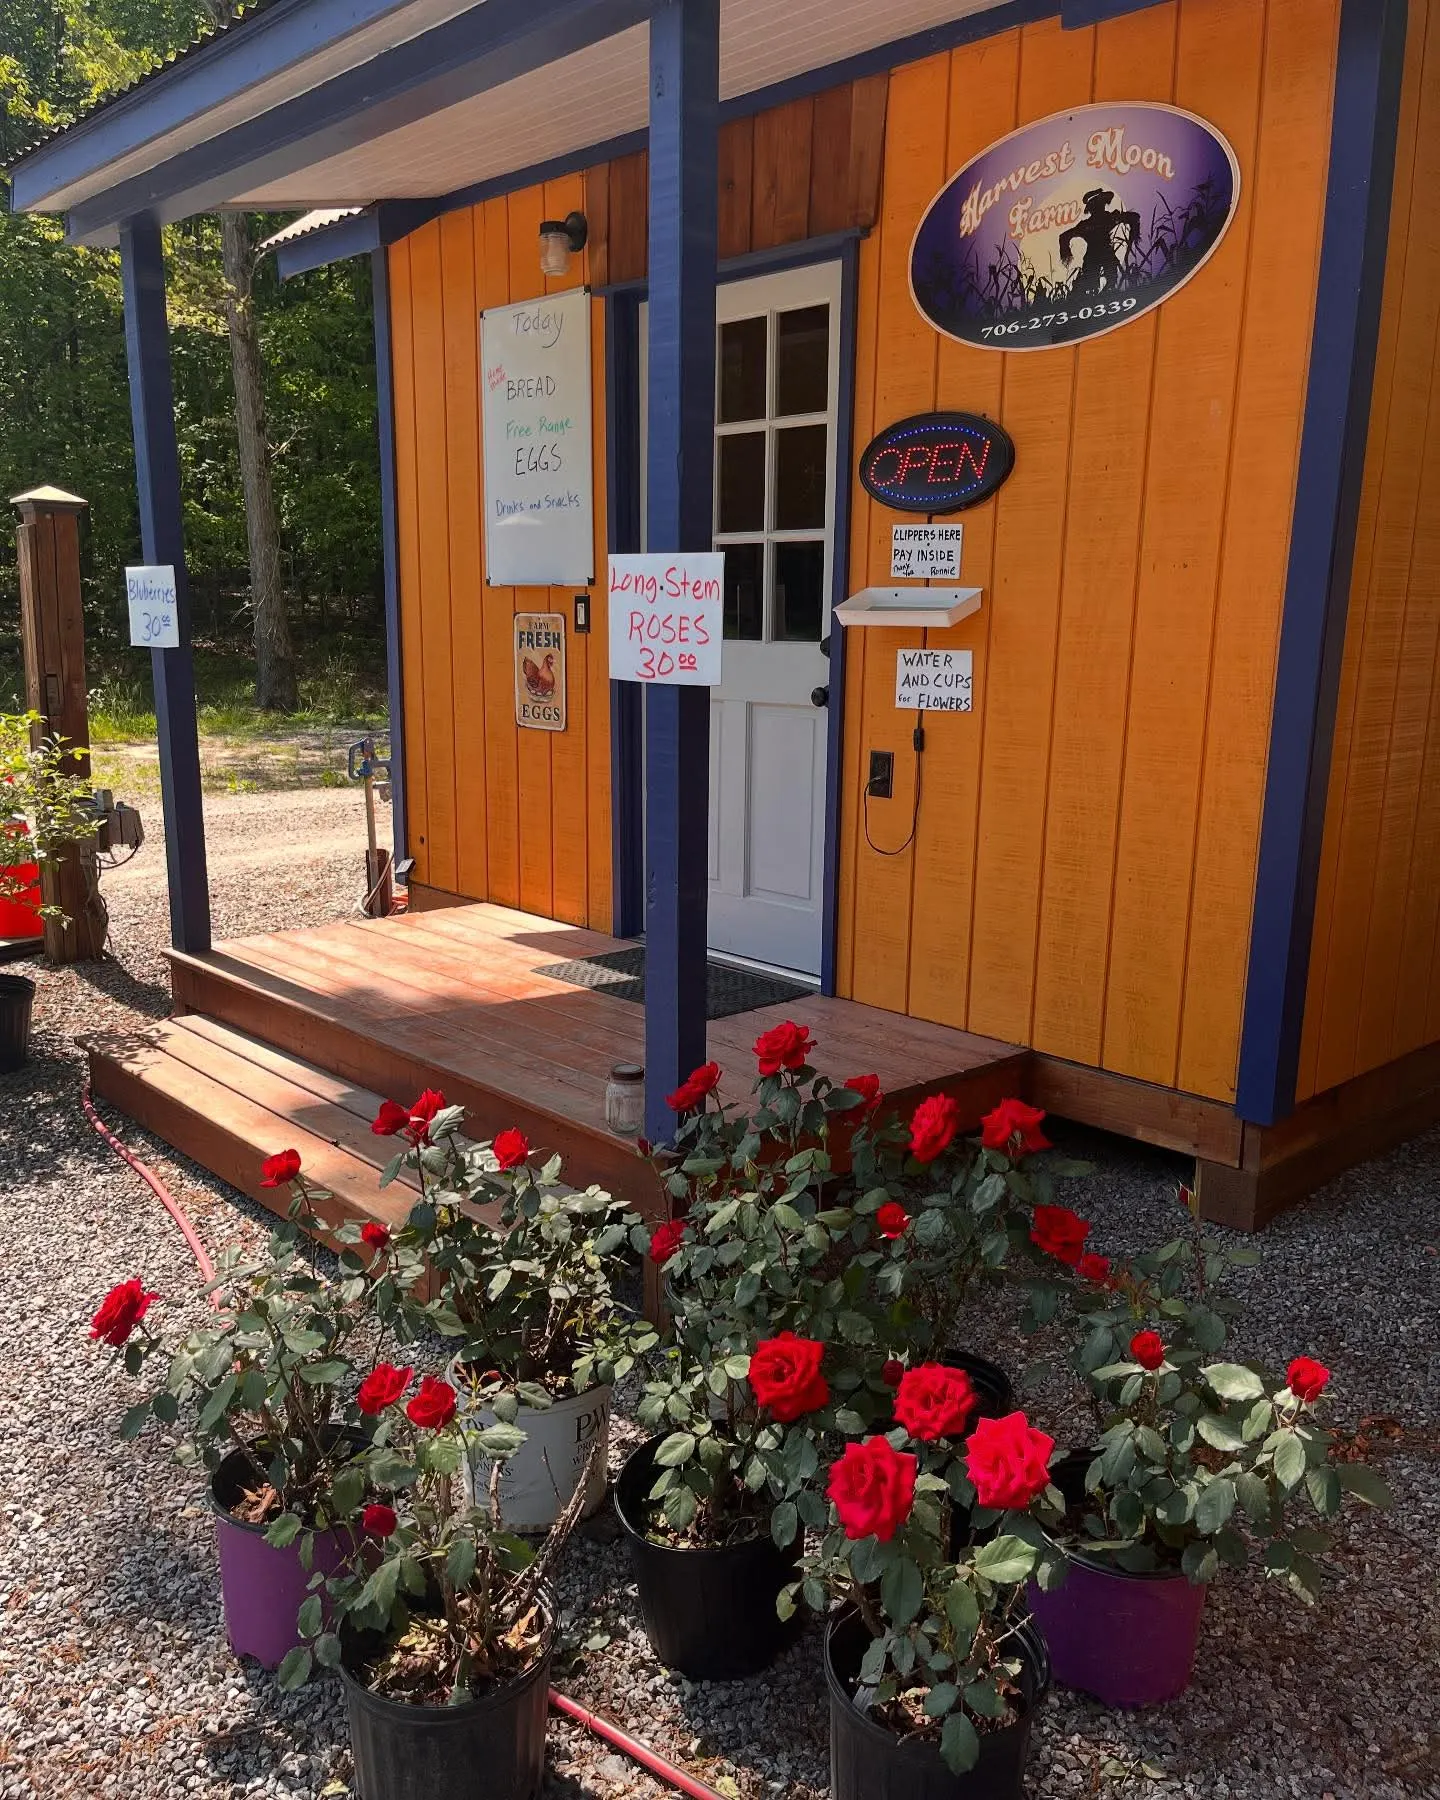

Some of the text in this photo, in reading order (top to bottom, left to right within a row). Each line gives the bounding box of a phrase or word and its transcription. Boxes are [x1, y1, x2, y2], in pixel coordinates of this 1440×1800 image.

[960, 125, 1175, 238] Harvest Moon
[1009, 195, 1083, 239] Farm
[513, 307, 564, 348] Today
[981, 297, 1137, 339] 706-273-0339
[507, 376, 556, 401] BREAD
[506, 416, 573, 440] Free Range
[515, 443, 562, 476] EGGS
[870, 439, 991, 487] OPEN
[495, 490, 581, 516] Drinks and Snacks
[893, 529, 961, 542] CLIPPERS HERE
[893, 549, 954, 562] PAY INSIDE
[610, 566, 720, 604] Long Stem
[528, 621, 550, 630] FARM
[629, 611, 710, 645] ROSES
[518, 631, 561, 651] FRESH
[903, 653, 953, 668] WATER
[902, 673, 972, 689] AND CUPS
[522, 704, 560, 721] EGGS
[918, 693, 971, 712] FLOWERS
